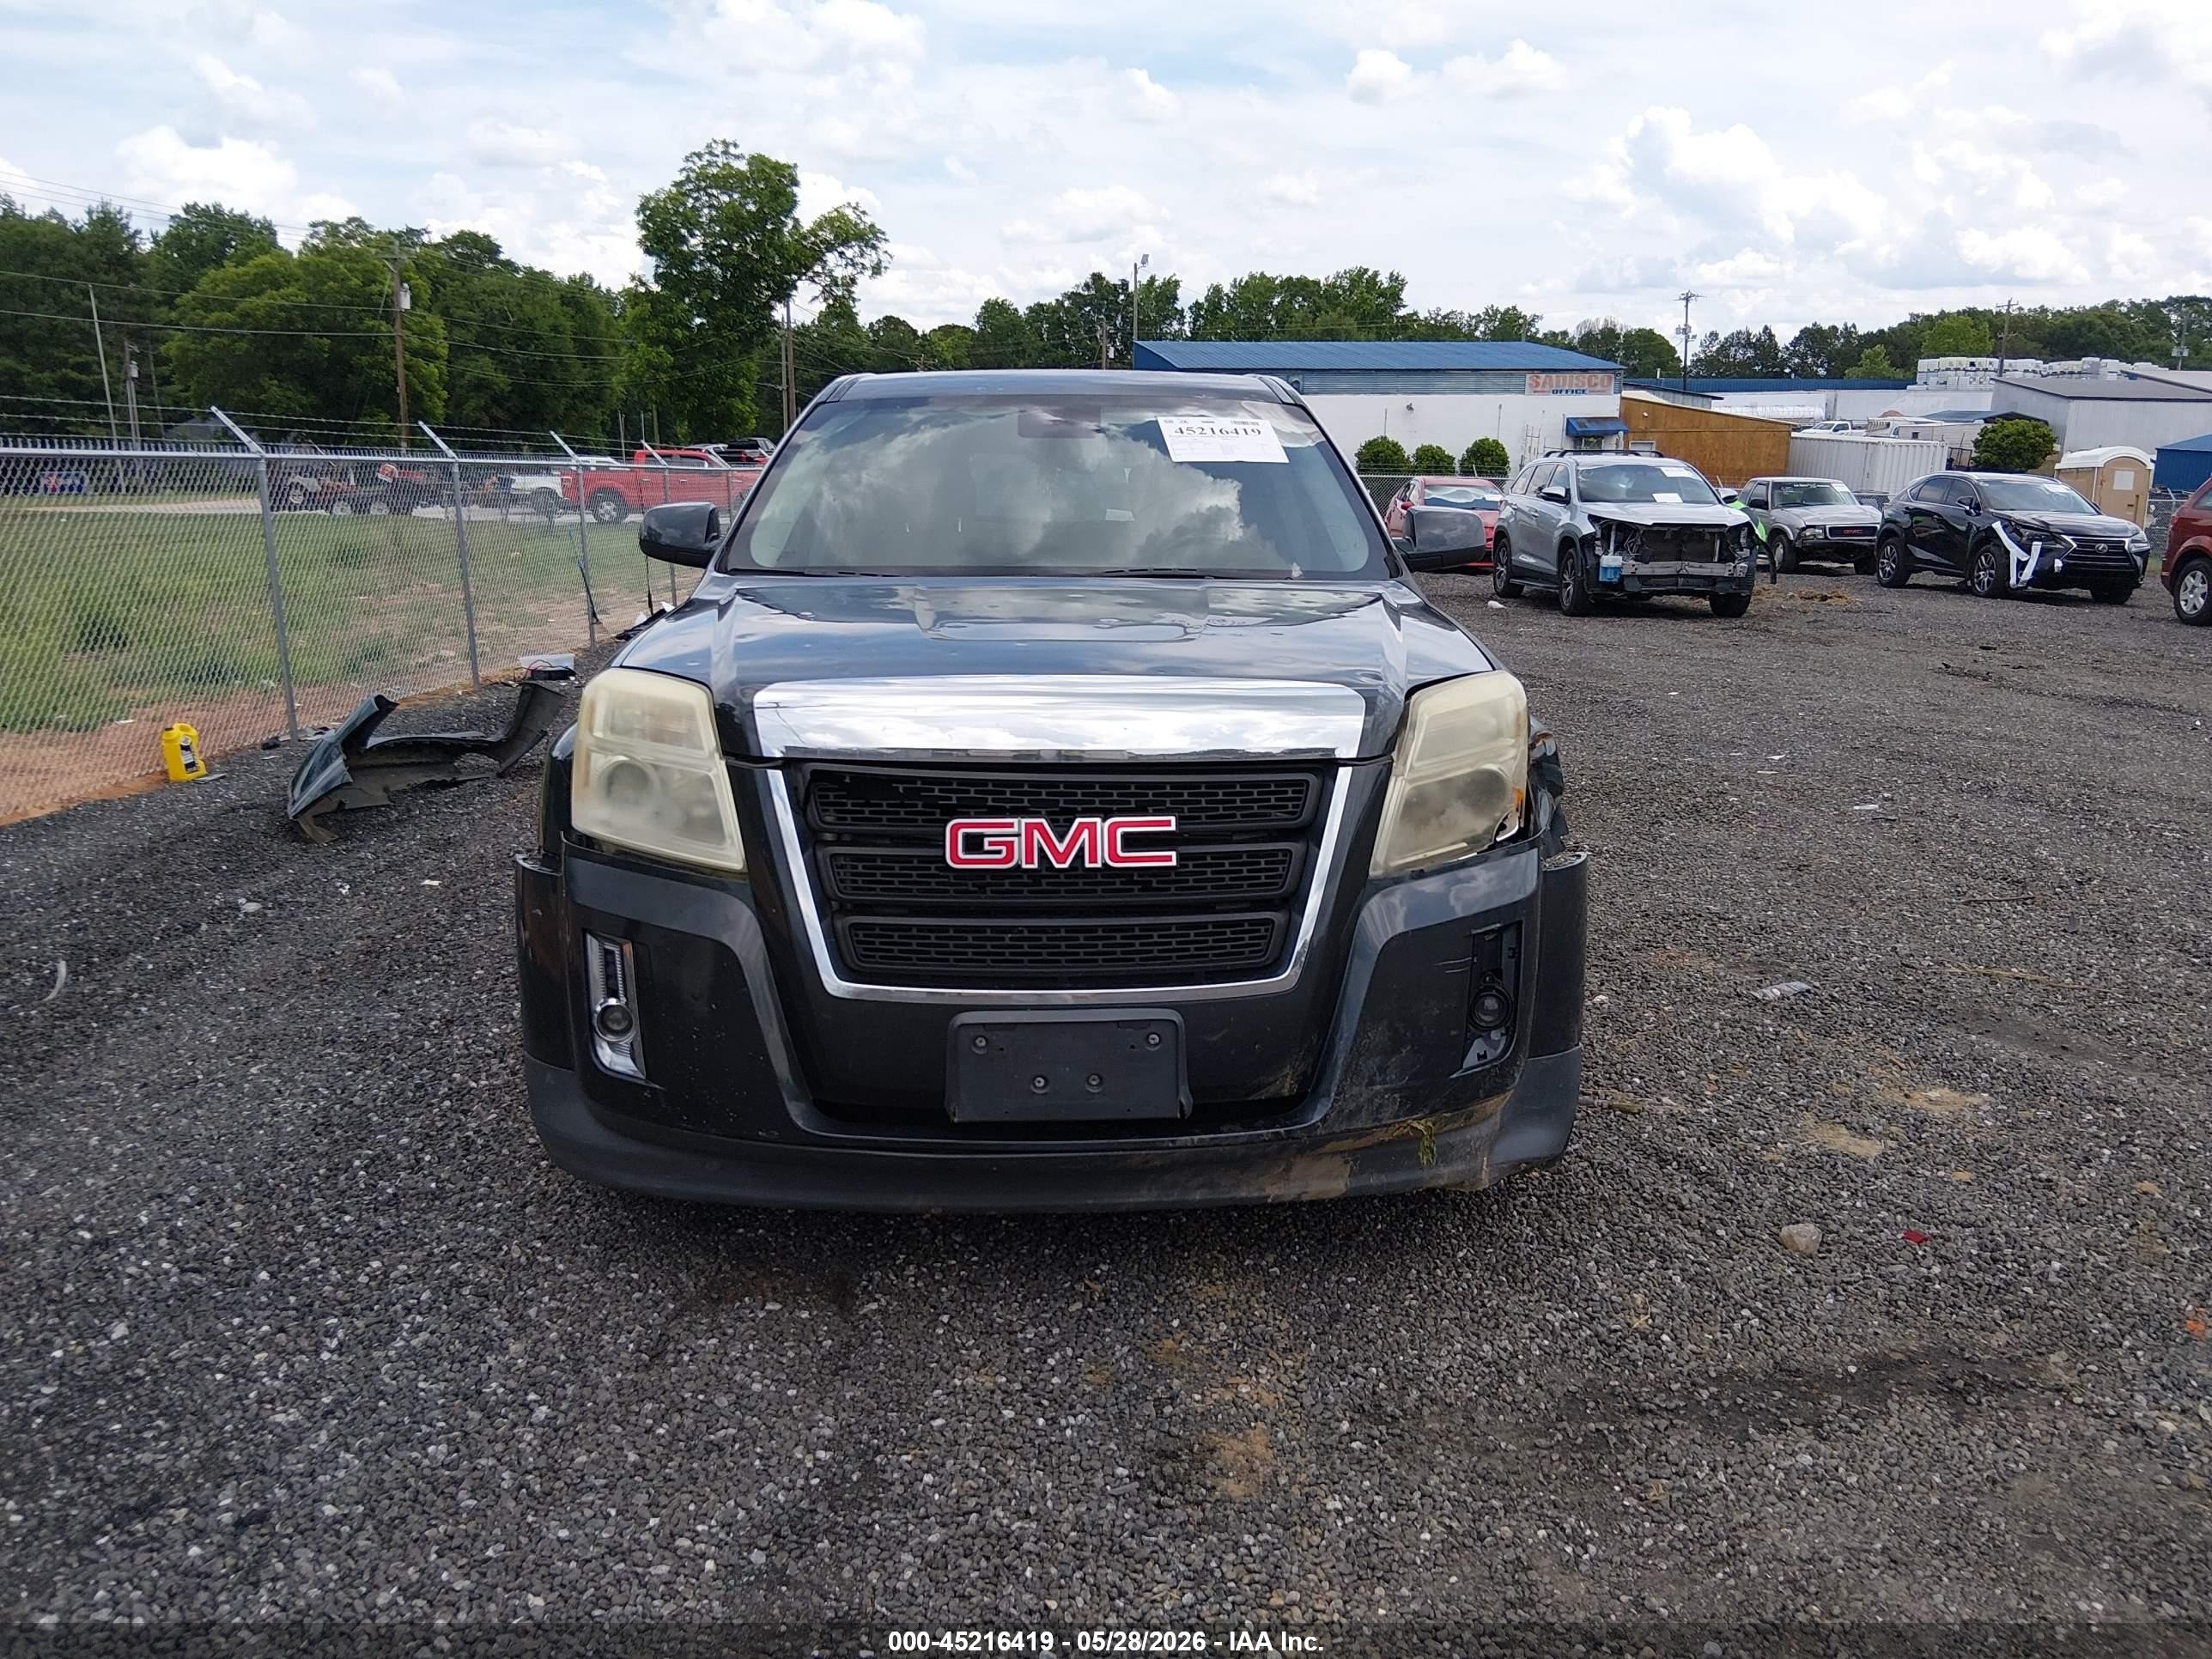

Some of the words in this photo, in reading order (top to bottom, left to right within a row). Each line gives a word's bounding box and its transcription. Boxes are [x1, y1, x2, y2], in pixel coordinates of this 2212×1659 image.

[1529, 374, 1613, 388] SADISCO
[1174, 426, 1261, 436] 45216419
[945, 816, 1177, 869] GMC
